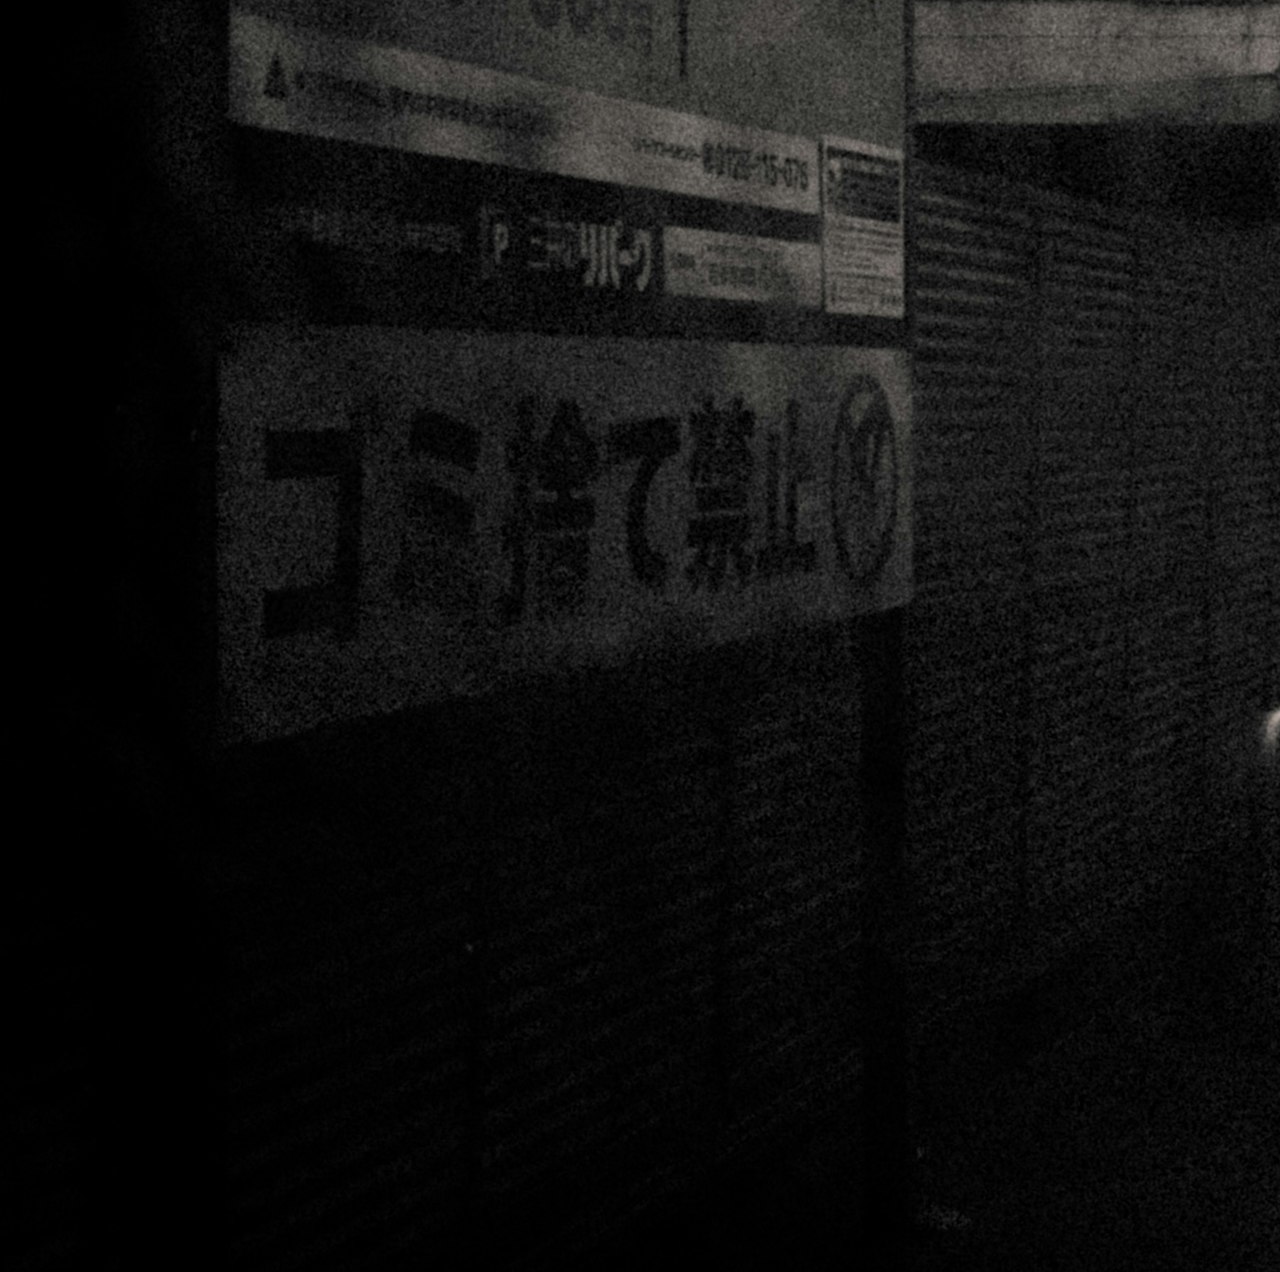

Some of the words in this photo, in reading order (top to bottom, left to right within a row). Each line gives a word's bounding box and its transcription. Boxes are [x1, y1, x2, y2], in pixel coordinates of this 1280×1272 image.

[263, 396, 818, 640] ゴミ捨て禁止
